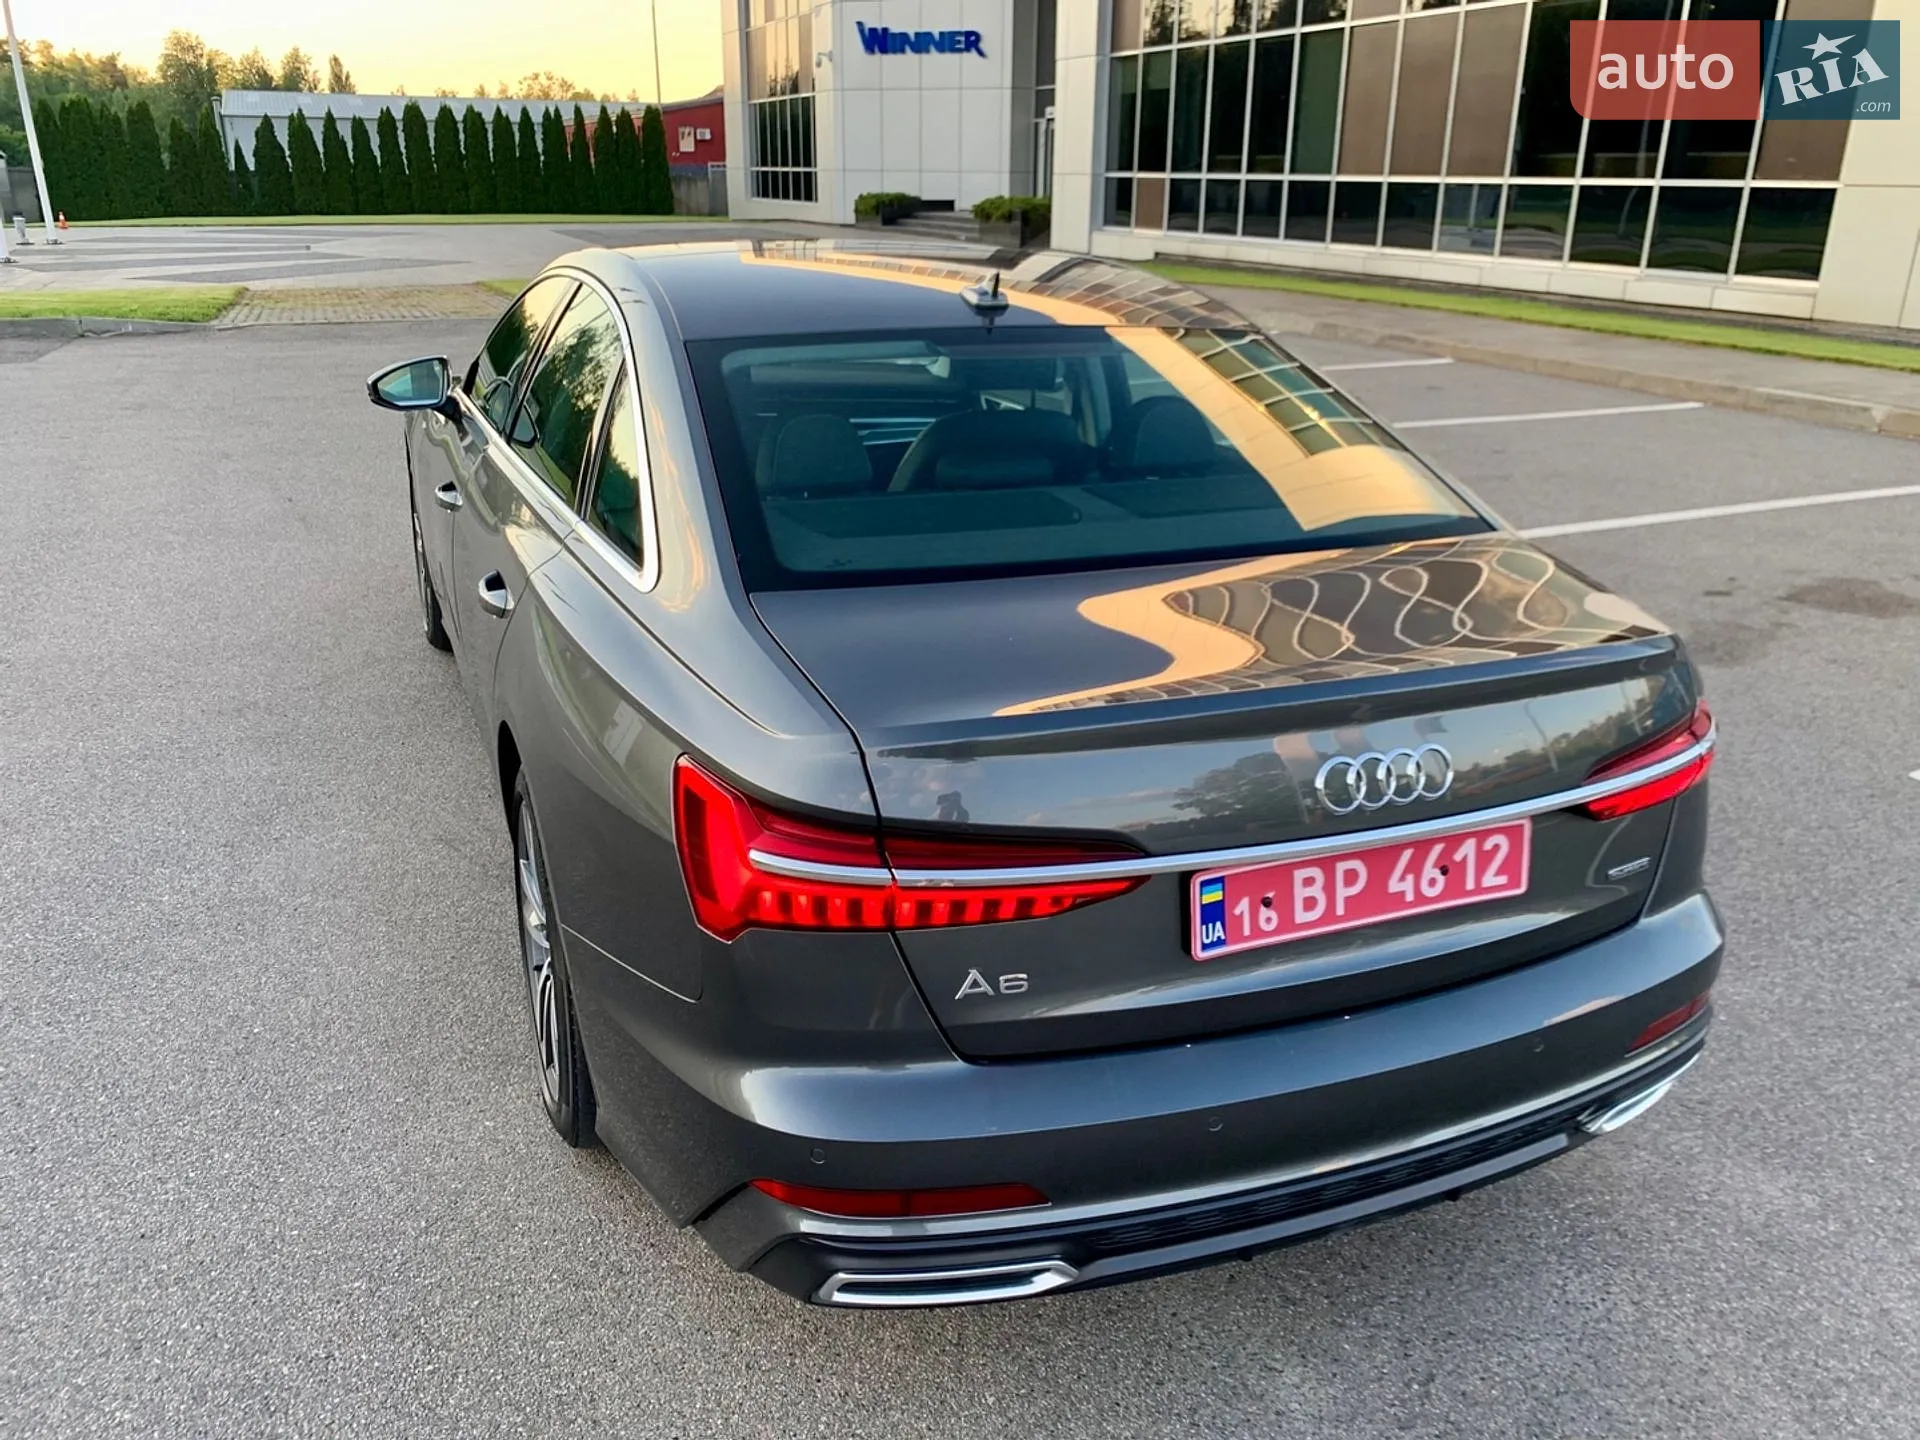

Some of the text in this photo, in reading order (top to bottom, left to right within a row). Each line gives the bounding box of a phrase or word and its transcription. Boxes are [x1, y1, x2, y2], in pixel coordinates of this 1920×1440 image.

[855, 21, 988, 58] WINNER
[1232, 834, 1510, 937] 16 BP 4612
[1201, 922, 1227, 945] UA
[954, 967, 1029, 1000] A6
